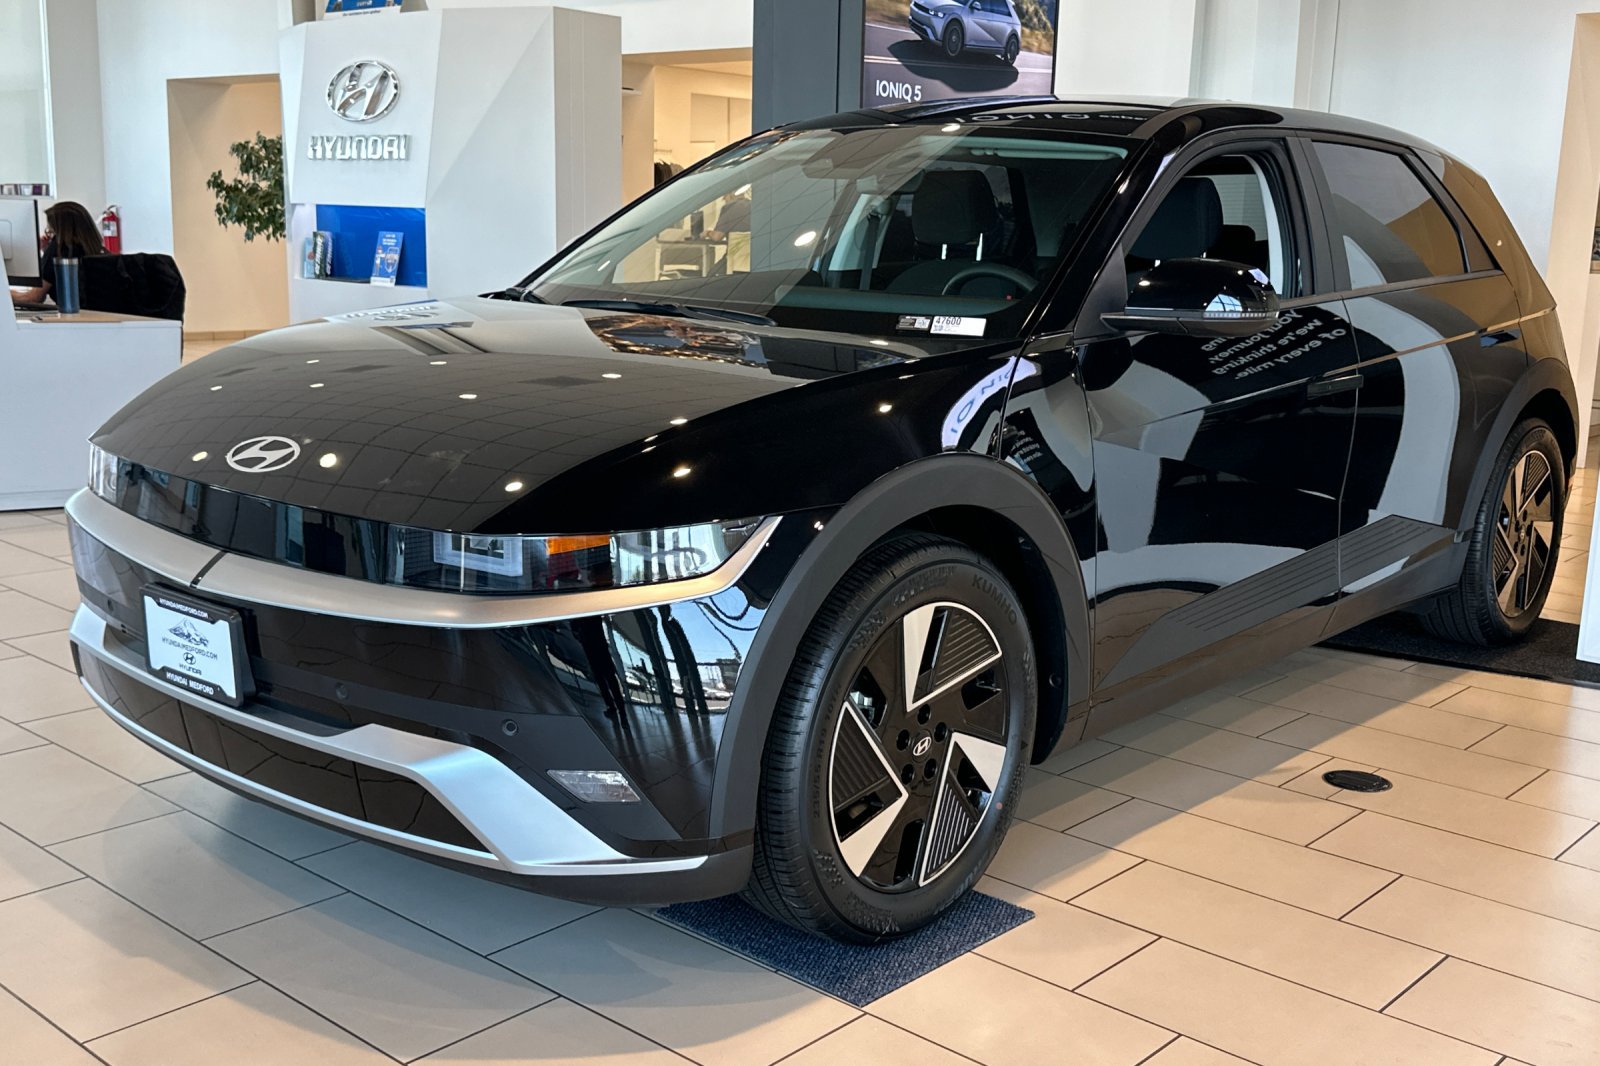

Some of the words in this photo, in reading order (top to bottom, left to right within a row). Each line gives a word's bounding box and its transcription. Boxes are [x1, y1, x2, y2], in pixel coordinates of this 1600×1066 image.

[875, 79, 912, 103] IONIQ
[913, 84, 922, 101] 5
[307, 134, 408, 160] HYUNDAI
[935, 316, 961, 326] 47600
[972, 574, 1018, 626] KUMHO
[166, 672, 188, 686] HYUNDAI
[189, 680, 214, 695] MEDFORD
